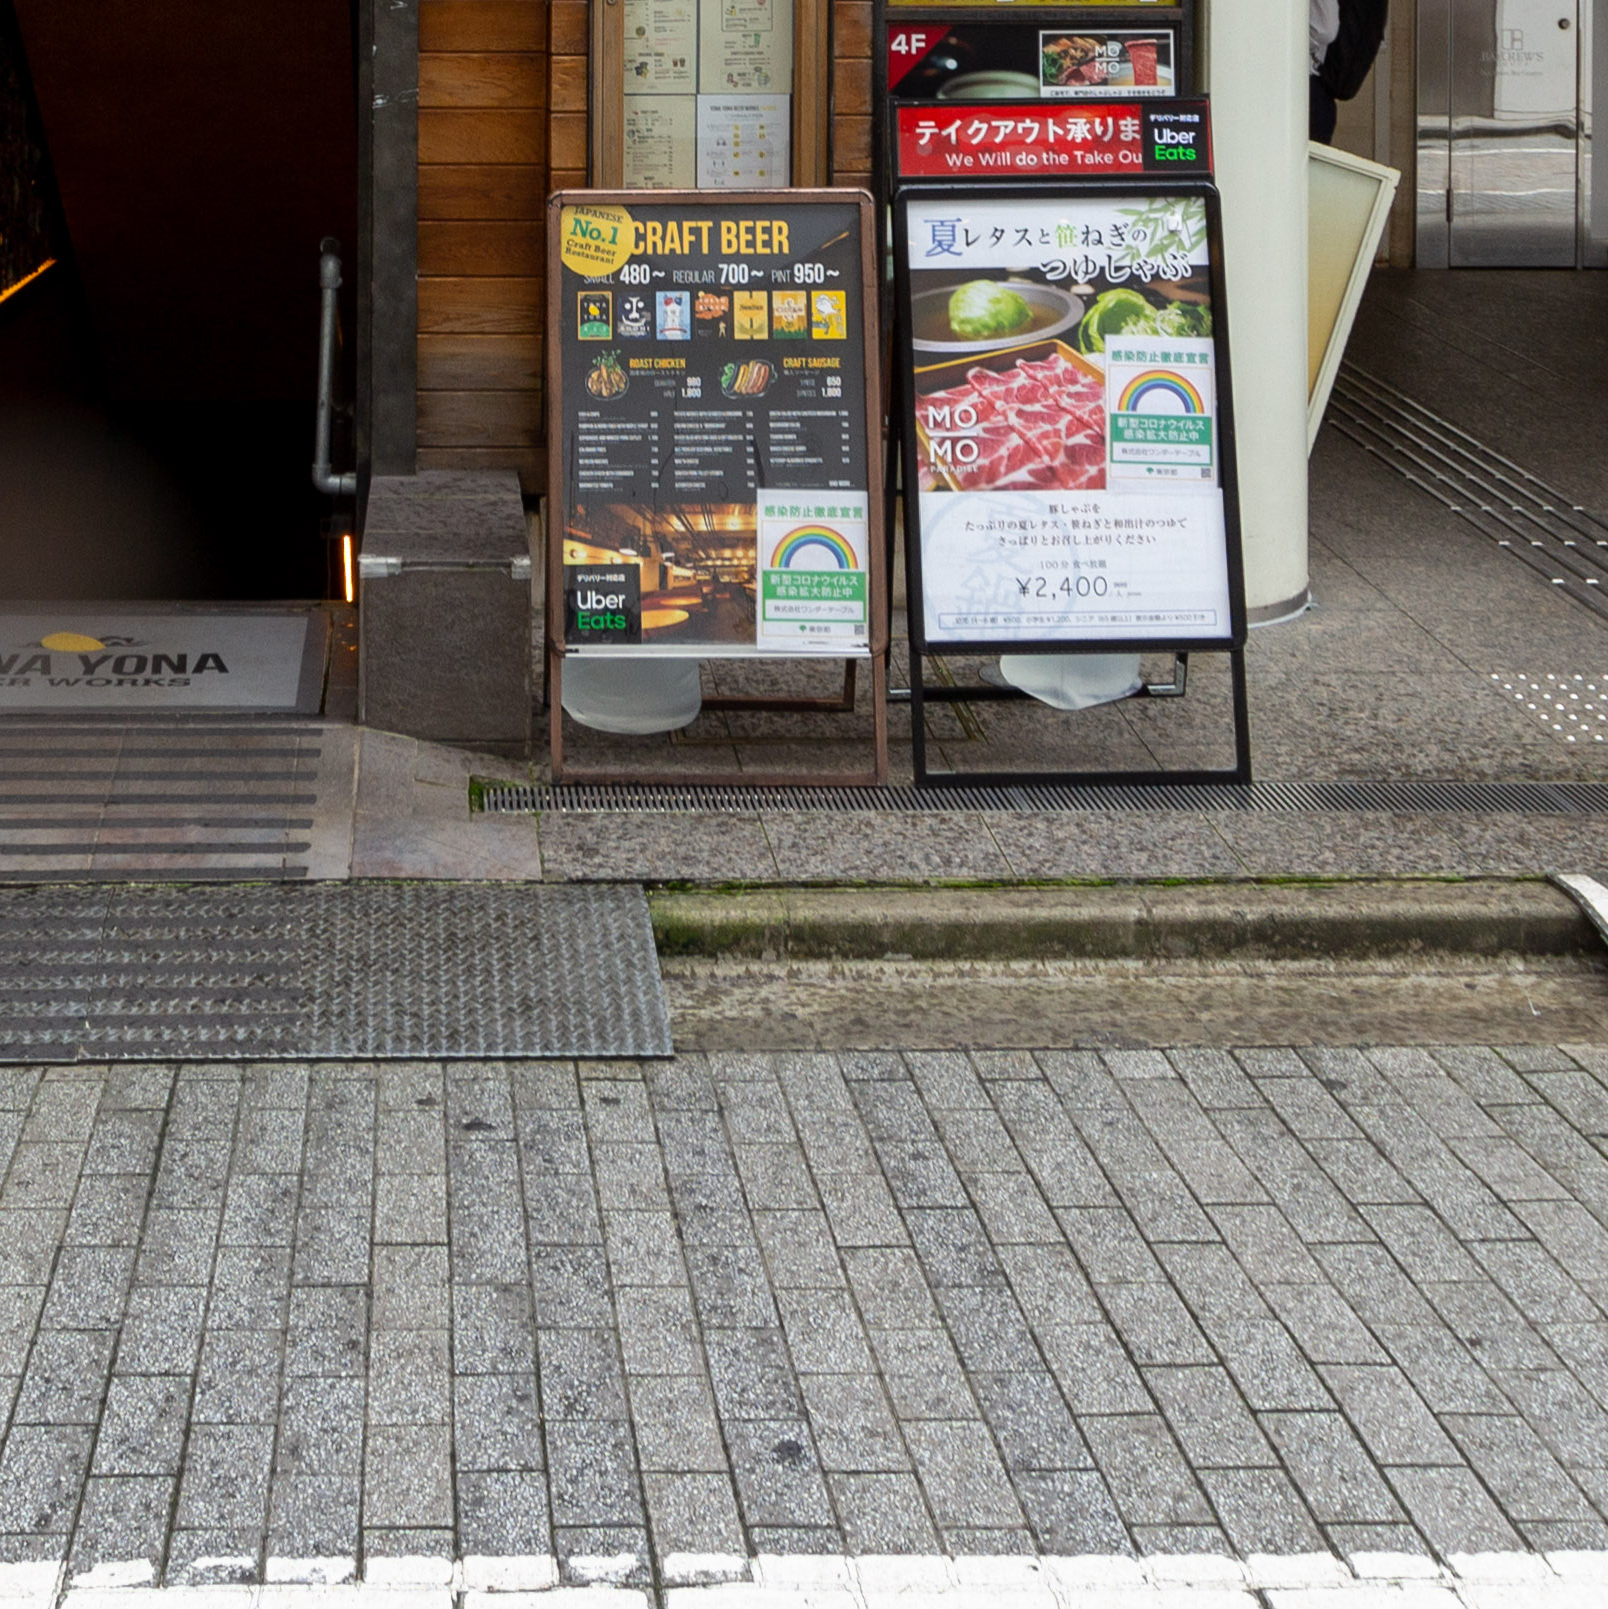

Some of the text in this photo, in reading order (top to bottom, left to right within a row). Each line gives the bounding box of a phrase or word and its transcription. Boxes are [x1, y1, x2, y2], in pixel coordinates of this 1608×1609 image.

[890, 33, 927, 55] 4F
[915, 116, 1142, 145] テイクアウト承りま
[1153, 128, 1196, 144] Uber
[945, 152, 974, 167] We
[979, 151, 1011, 166] Will
[1015, 151, 1038, 166] do
[1041, 151, 1069, 165] the
[1074, 150, 1114, 165] Take
[1154, 145, 1197, 161] Eats
[573, 205, 624, 225] JAPANESE
[569, 218, 620, 246] No.1
[631, 220, 790, 256] CRAFT BEER
[923, 217, 1148, 257] 夏レタスと笹ねぎの
[564, 246, 615, 266] Restaurant
[565, 238, 618, 258] Craft Beer
[672, 269, 716, 284] REGULAR
[771, 269, 792, 284] PINT
[1040, 253, 1193, 283] つゆしゃぶ
[927, 405, 979, 429] MO
[929, 439, 980, 464] MO
[1048, 503, 1102, 515] 豚しゃぶを
[770, 573, 859, 587] 新型コロナウイルス
[1014, 575, 1110, 600] ¥2,400
[576, 590, 627, 610] Uber
[577, 611, 627, 630] Eats
[81, 652, 229, 676] YONA
[48, 677, 191, 688] WORKS
